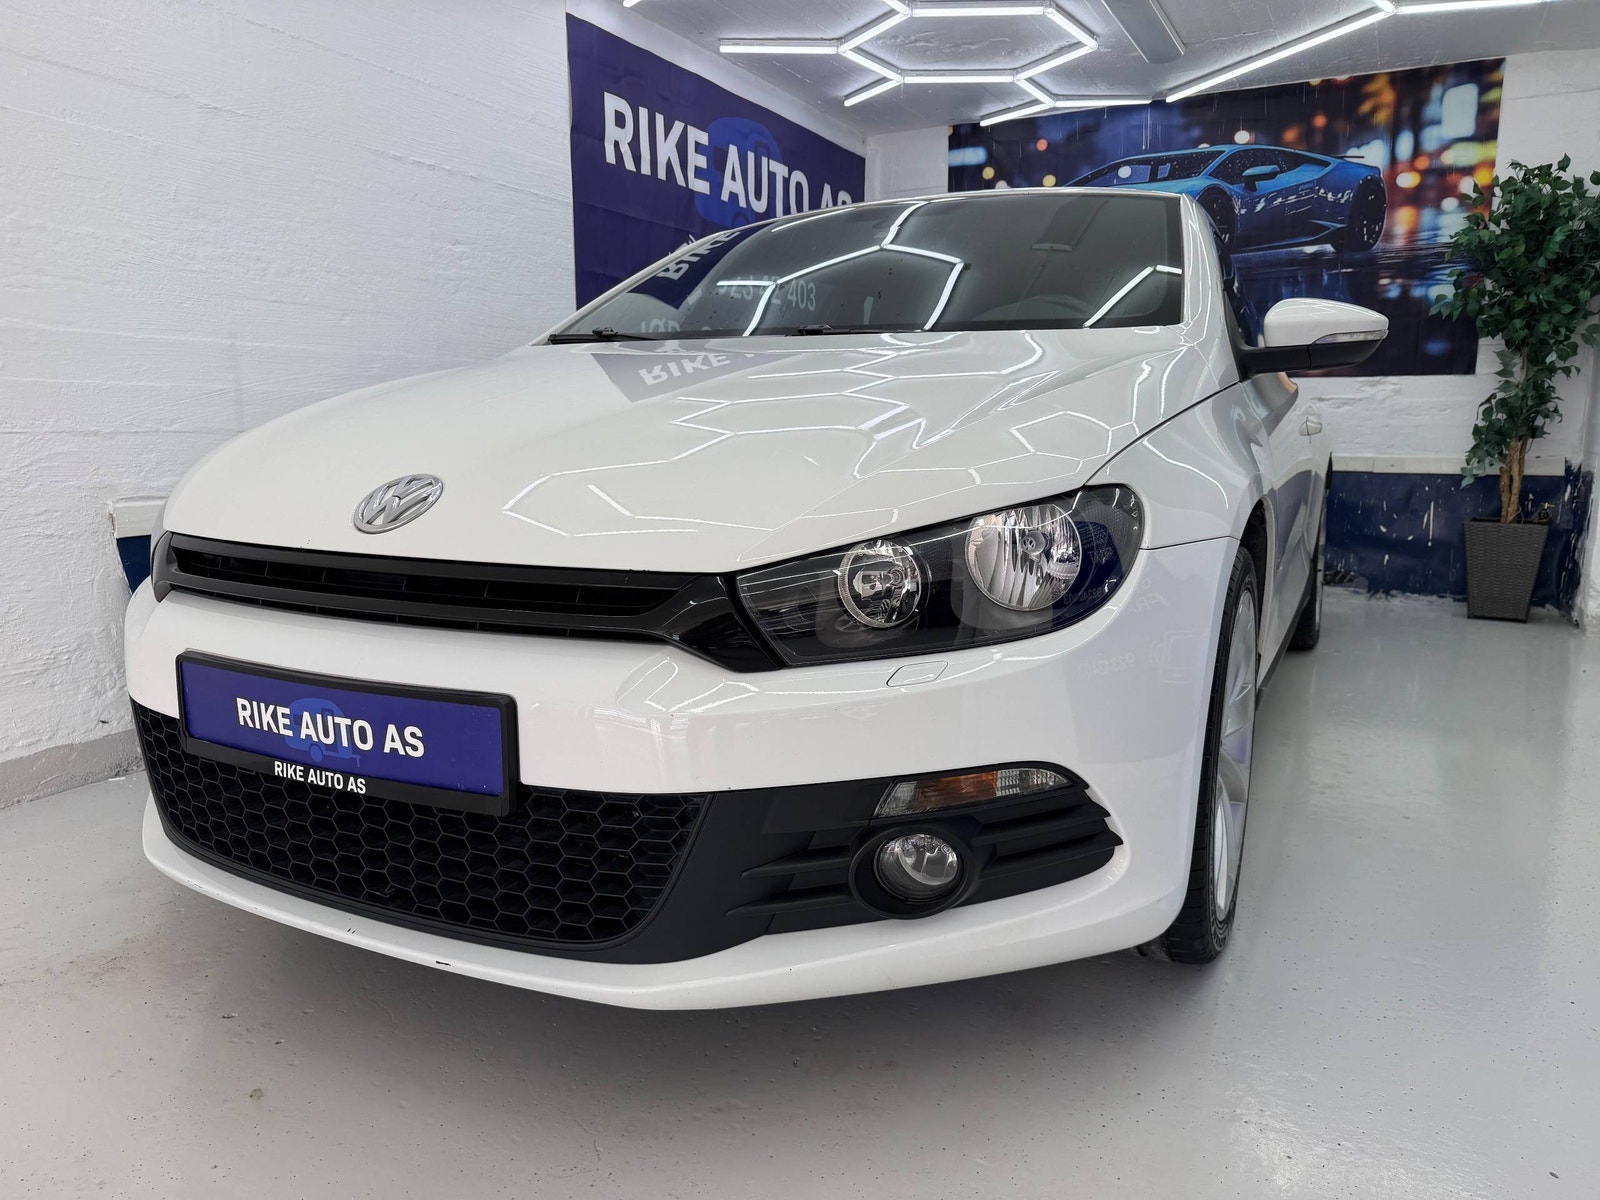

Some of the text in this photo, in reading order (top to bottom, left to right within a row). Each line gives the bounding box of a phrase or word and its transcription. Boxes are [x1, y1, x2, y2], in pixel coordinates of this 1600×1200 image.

[603, 91, 711, 195] RIKE
[720, 143, 810, 218] AUTO
[787, 279, 817, 312] 403
[236, 697, 425, 758] RIKE AUTO AS
[274, 760, 366, 795] RIKE AUTO AS
